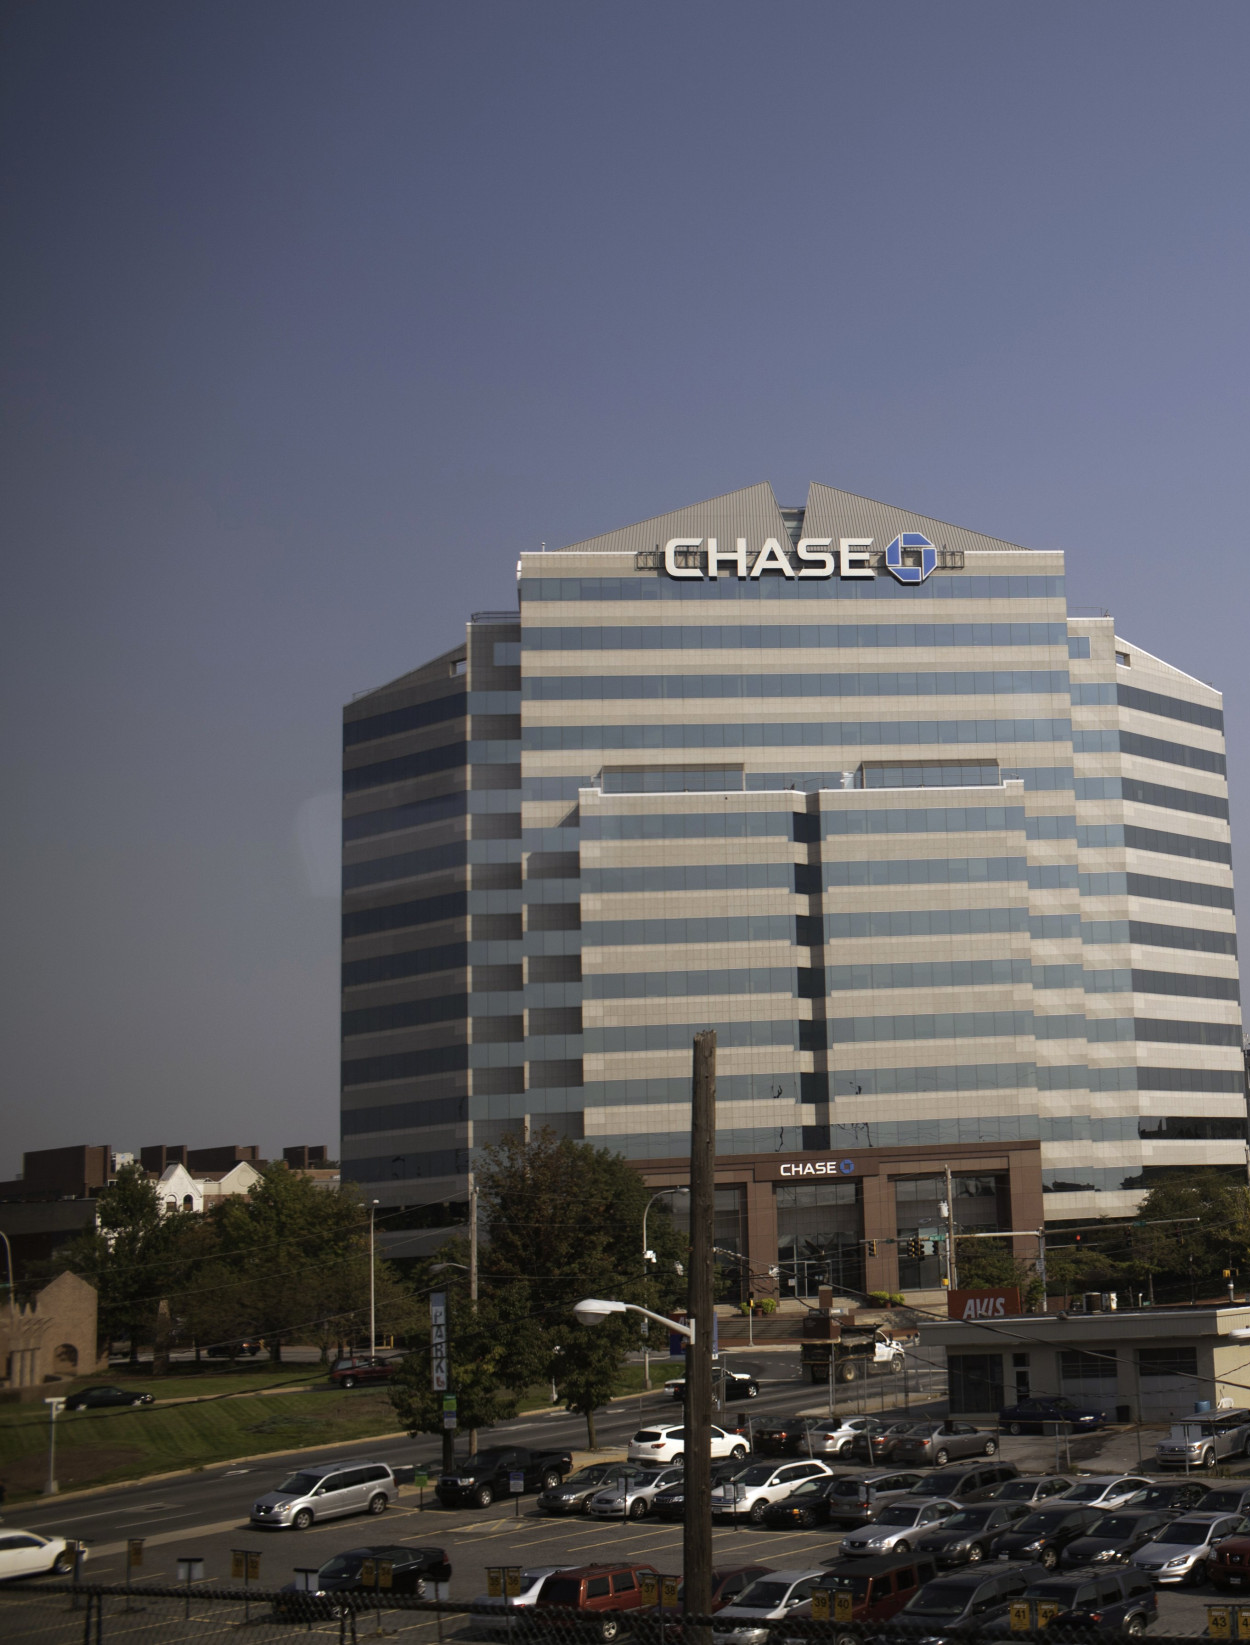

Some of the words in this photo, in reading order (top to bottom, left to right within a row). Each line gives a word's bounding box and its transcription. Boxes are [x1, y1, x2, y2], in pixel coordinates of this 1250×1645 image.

[664, 537, 876, 578] CHASE
[780, 1161, 837, 1176] CHASE
[962, 1297, 1005, 1319] AVIS
[433, 1310, 444, 1374] PARK
[508, 1576, 519, 1585] 36
[644, 1583, 655, 1593] 37
[664, 1585, 675, 1595] 38
[814, 1597, 827, 1608] 39
[837, 1599, 849, 1609] 40
[1014, 1609, 1026, 1619] 41
[1211, 1616, 1227, 1627] 43
